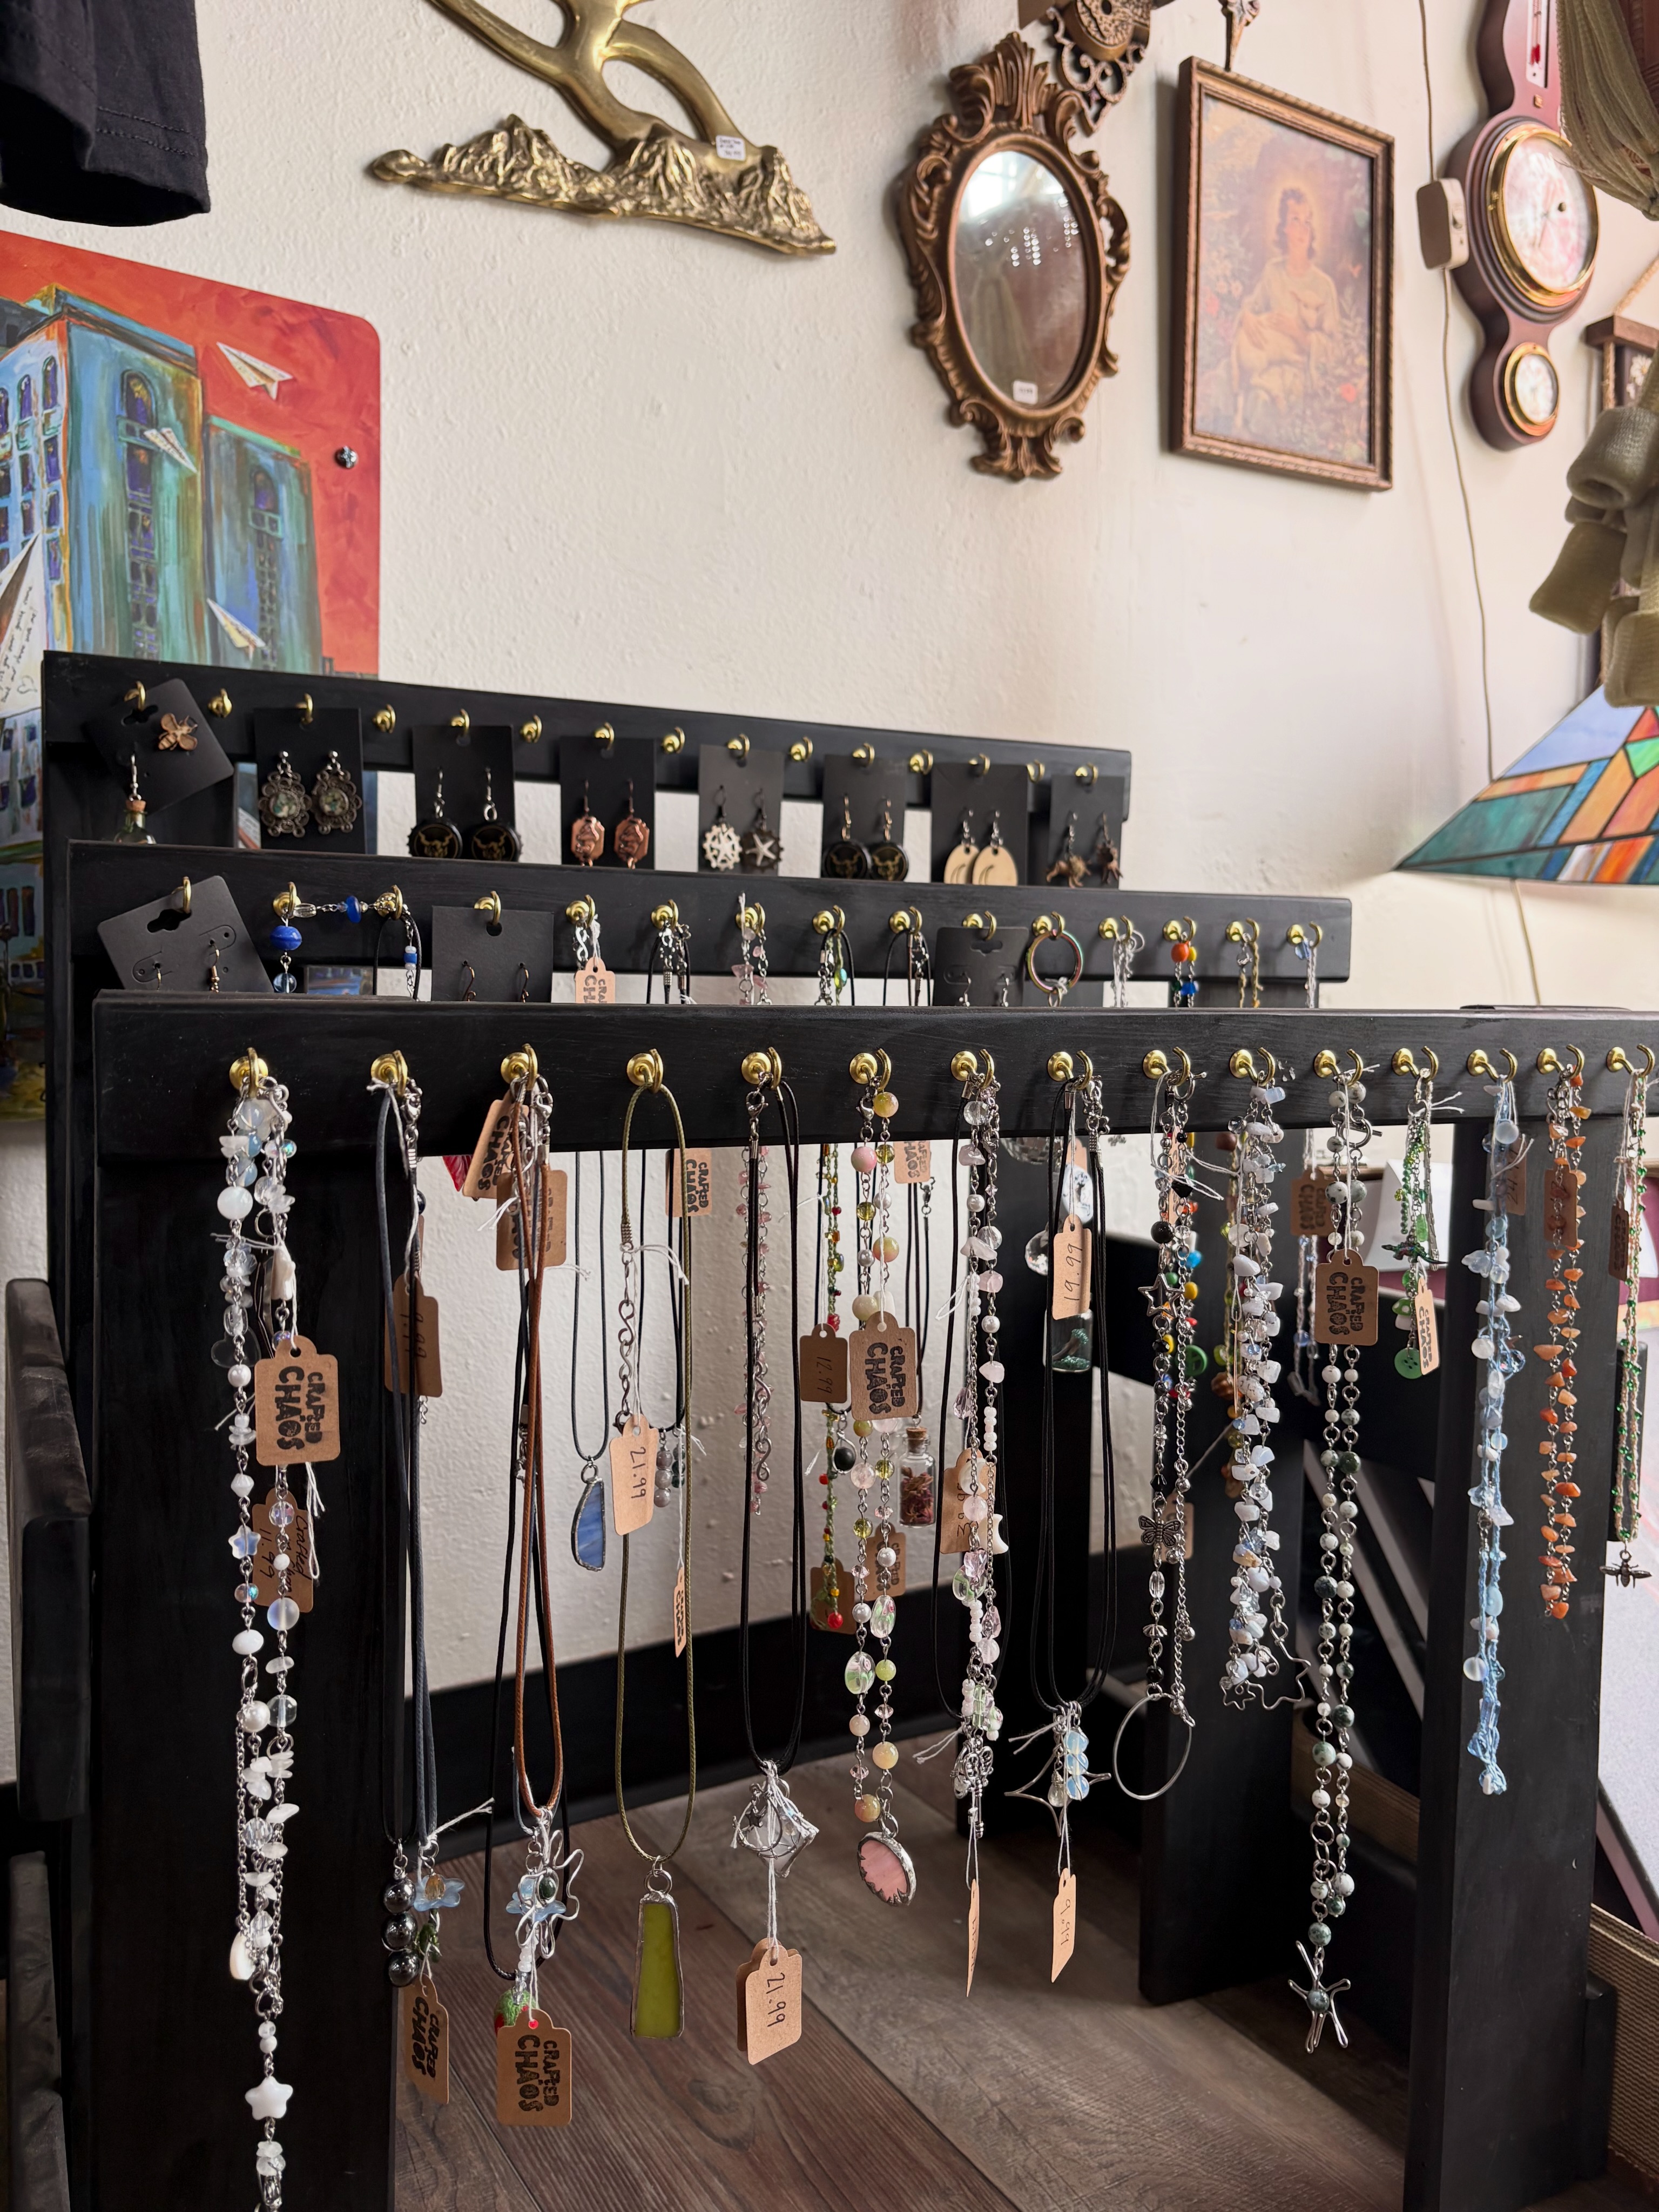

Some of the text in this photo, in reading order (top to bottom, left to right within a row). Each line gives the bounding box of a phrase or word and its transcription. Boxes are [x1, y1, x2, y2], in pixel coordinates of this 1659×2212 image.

[478, 1115, 510, 1190] CHAOS
[903, 1141, 920, 1178] HAOS
[1064, 1243, 1083, 1301] 19.99
[1326, 1272, 1350, 1335] CHAOS
[1419, 1306, 1429, 1368] CHAOS
[817, 1357, 832, 1394] 12.99
[865, 1342, 892, 1414] CHAOS
[274, 1366, 305, 1450] CHAOS
[630, 1446, 646, 1499] 21.99
[260, 1528, 275, 1579] 11.99
[293, 1515, 312, 1580] Crafted
[1060, 1899, 1071, 1945] 9.99
[766, 1972, 786, 2027] 21.99
[412, 1997, 429, 2075] CHAOS
[515, 2035, 544, 2112] CHAOS
